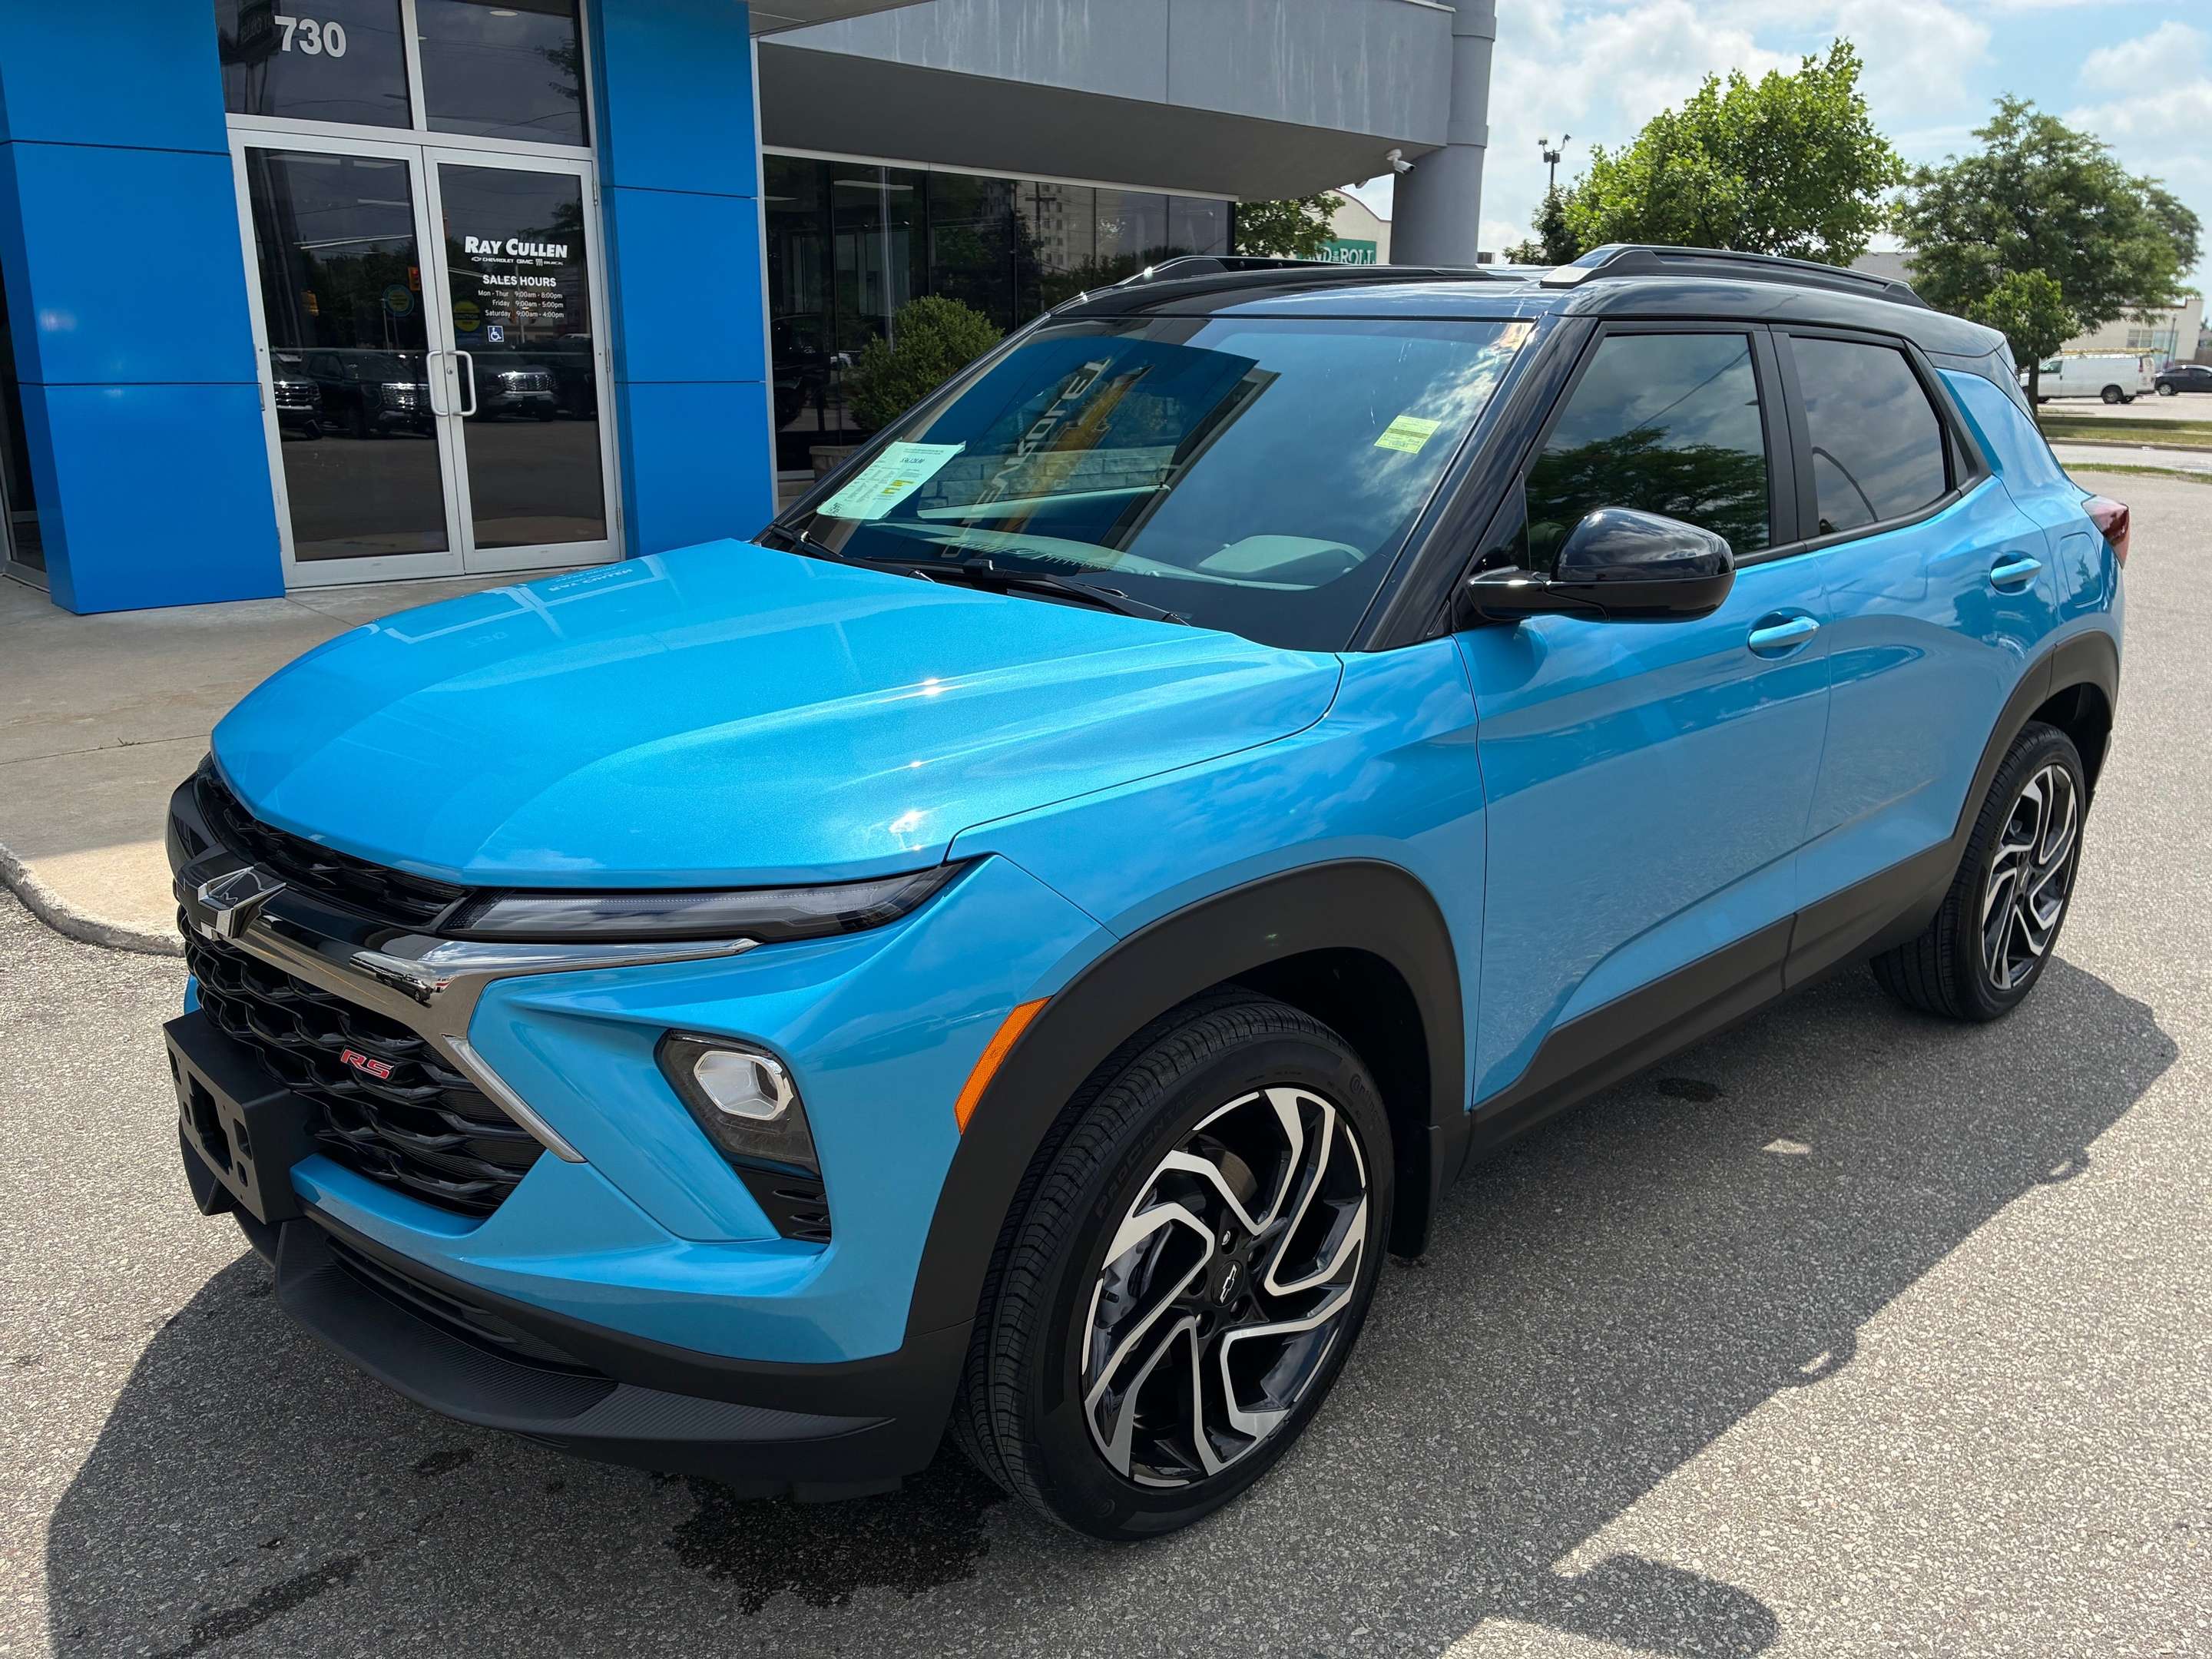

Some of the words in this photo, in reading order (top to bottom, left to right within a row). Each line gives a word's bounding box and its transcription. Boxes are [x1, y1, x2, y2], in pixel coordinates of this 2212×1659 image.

[274, 15, 346, 58] 730
[465, 236, 502, 254] RAY
[505, 238, 568, 258] CULLEN
[482, 274, 517, 285] SALES
[519, 276, 557, 286] HOURS
[340, 1048, 395, 1079] RS
